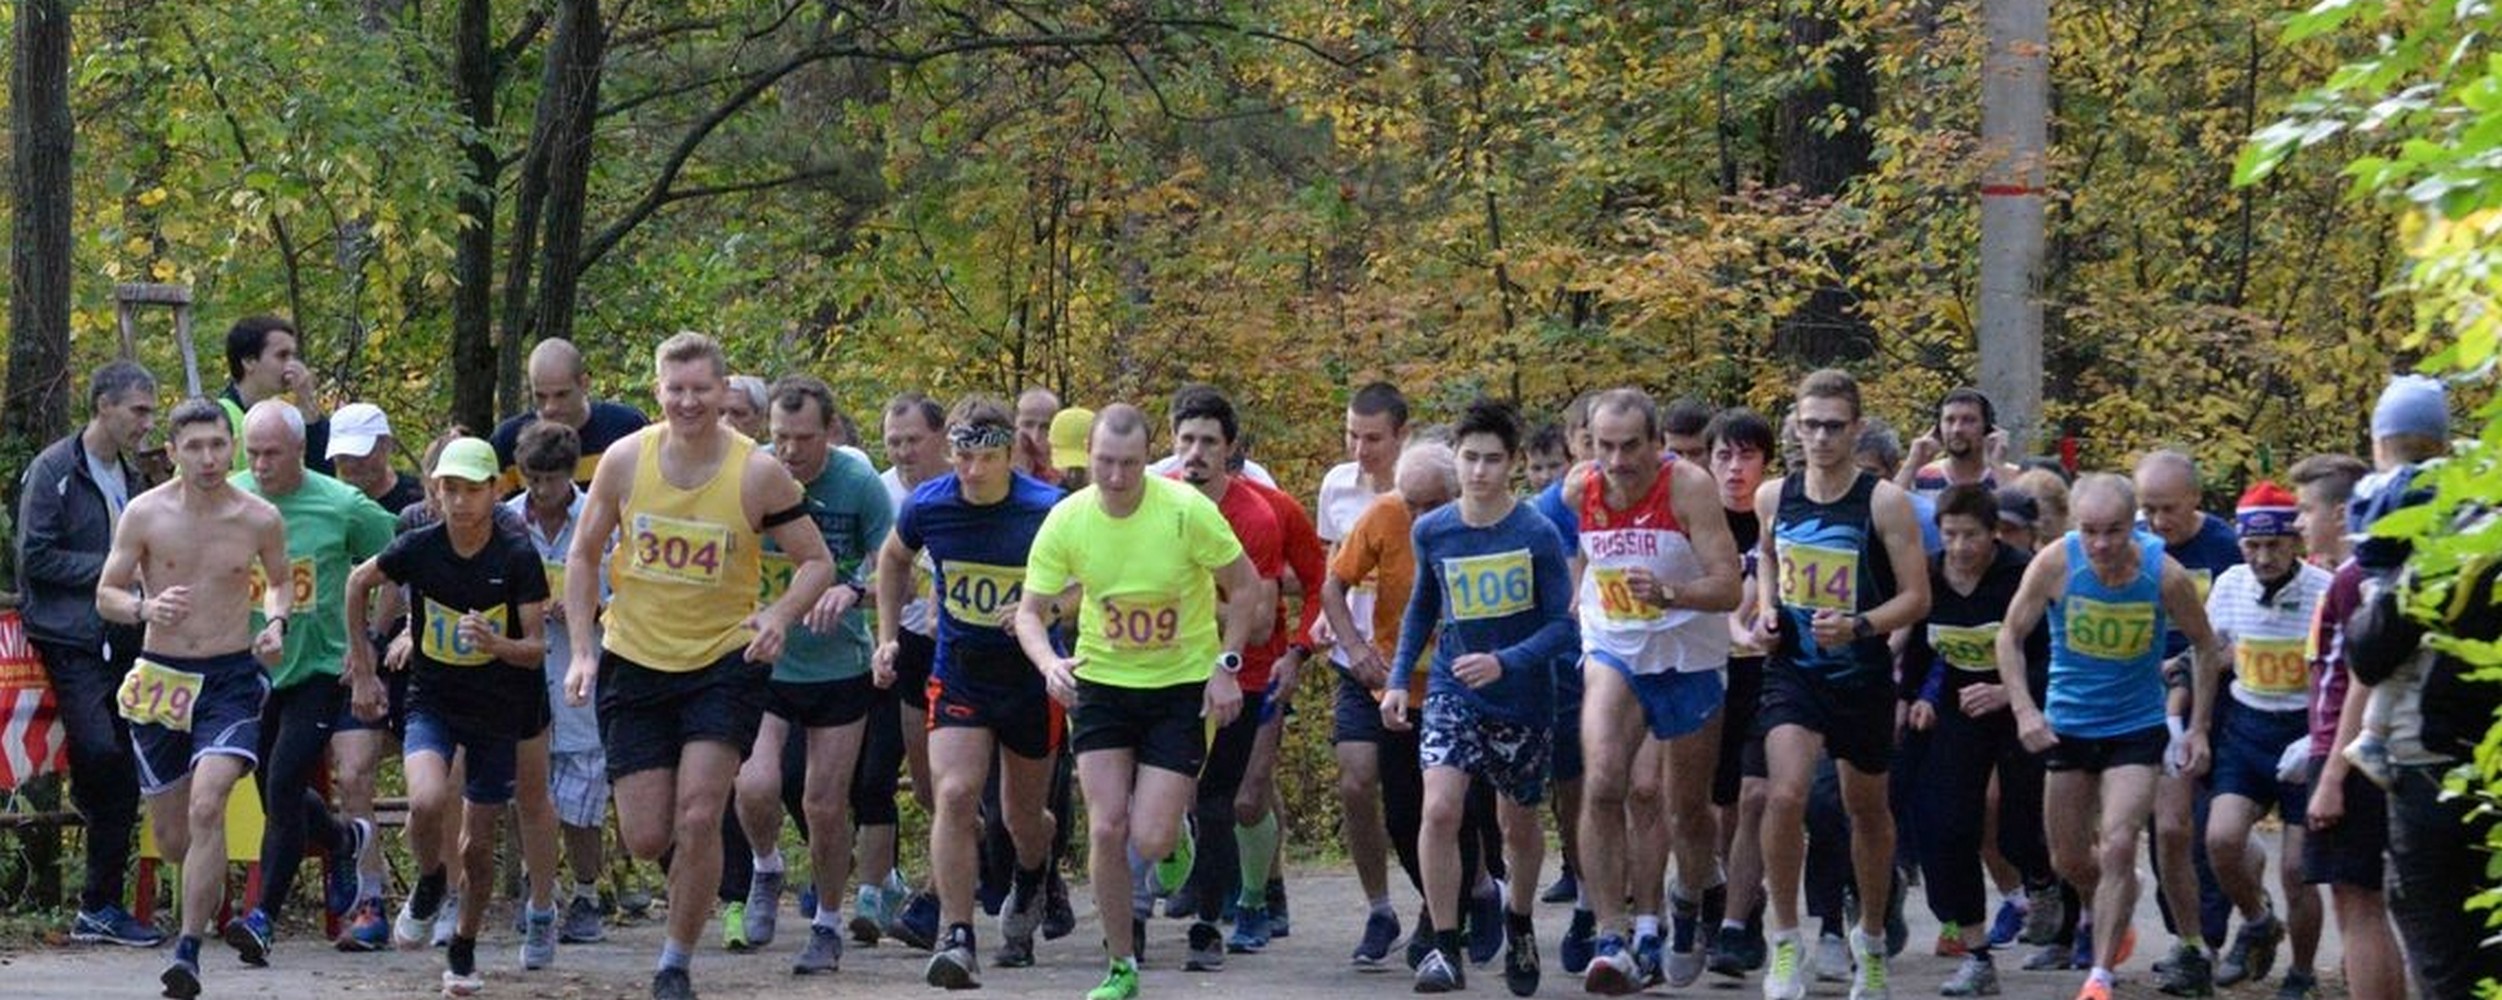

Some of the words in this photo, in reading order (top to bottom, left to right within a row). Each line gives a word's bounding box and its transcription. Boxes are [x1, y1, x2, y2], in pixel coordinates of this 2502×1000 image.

[638, 531, 719, 576] 304
[1592, 532, 1658, 557] RUSSIA
[950, 575, 1023, 614] 404
[1455, 566, 1529, 610] 106
[1782, 556, 1851, 602] 314
[1104, 602, 1178, 643] 309
[2073, 614, 2150, 651] 607
[2240, 645, 2305, 685] 709
[122, 673, 192, 721] 319
